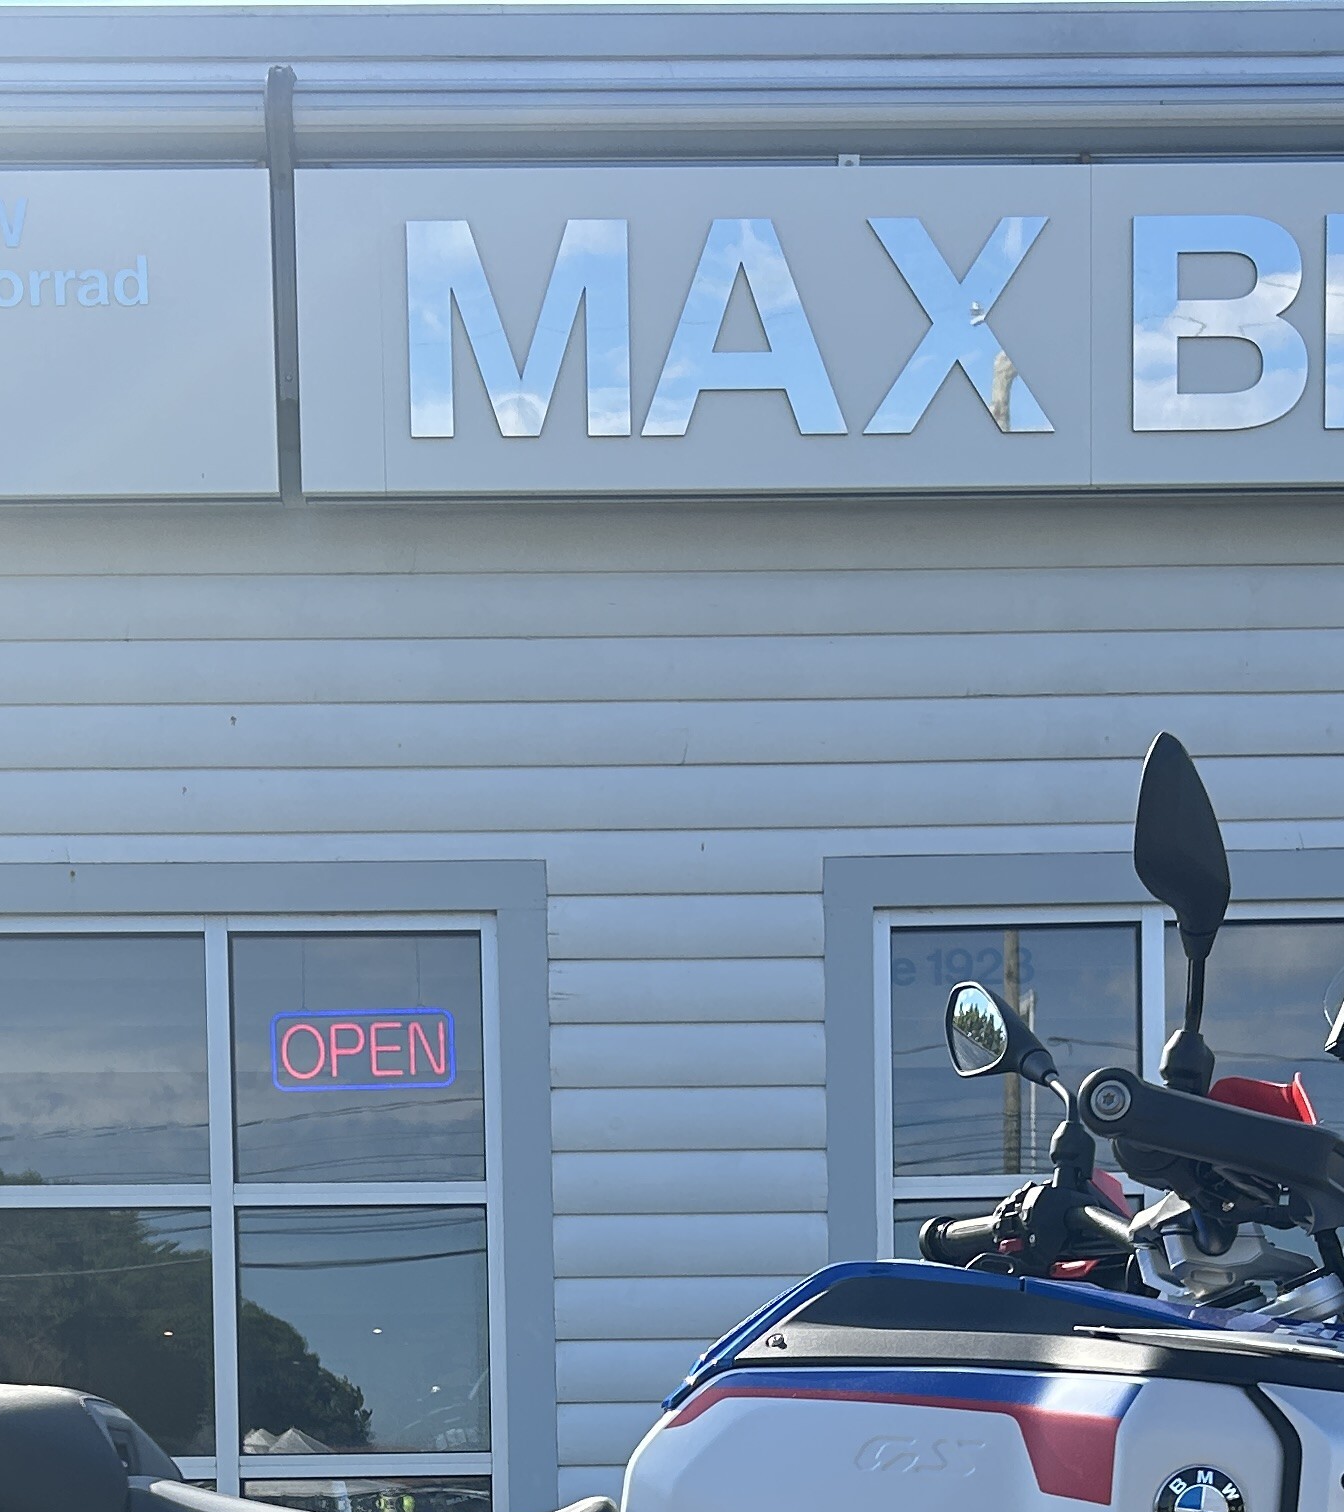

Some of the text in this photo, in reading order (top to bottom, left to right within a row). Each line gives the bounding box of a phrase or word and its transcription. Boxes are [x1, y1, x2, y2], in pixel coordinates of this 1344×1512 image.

[405, 216, 1055, 440] MAX
[279, 1020, 446, 1080] OPEN
[1168, 1469, 1240, 1501] BMW
